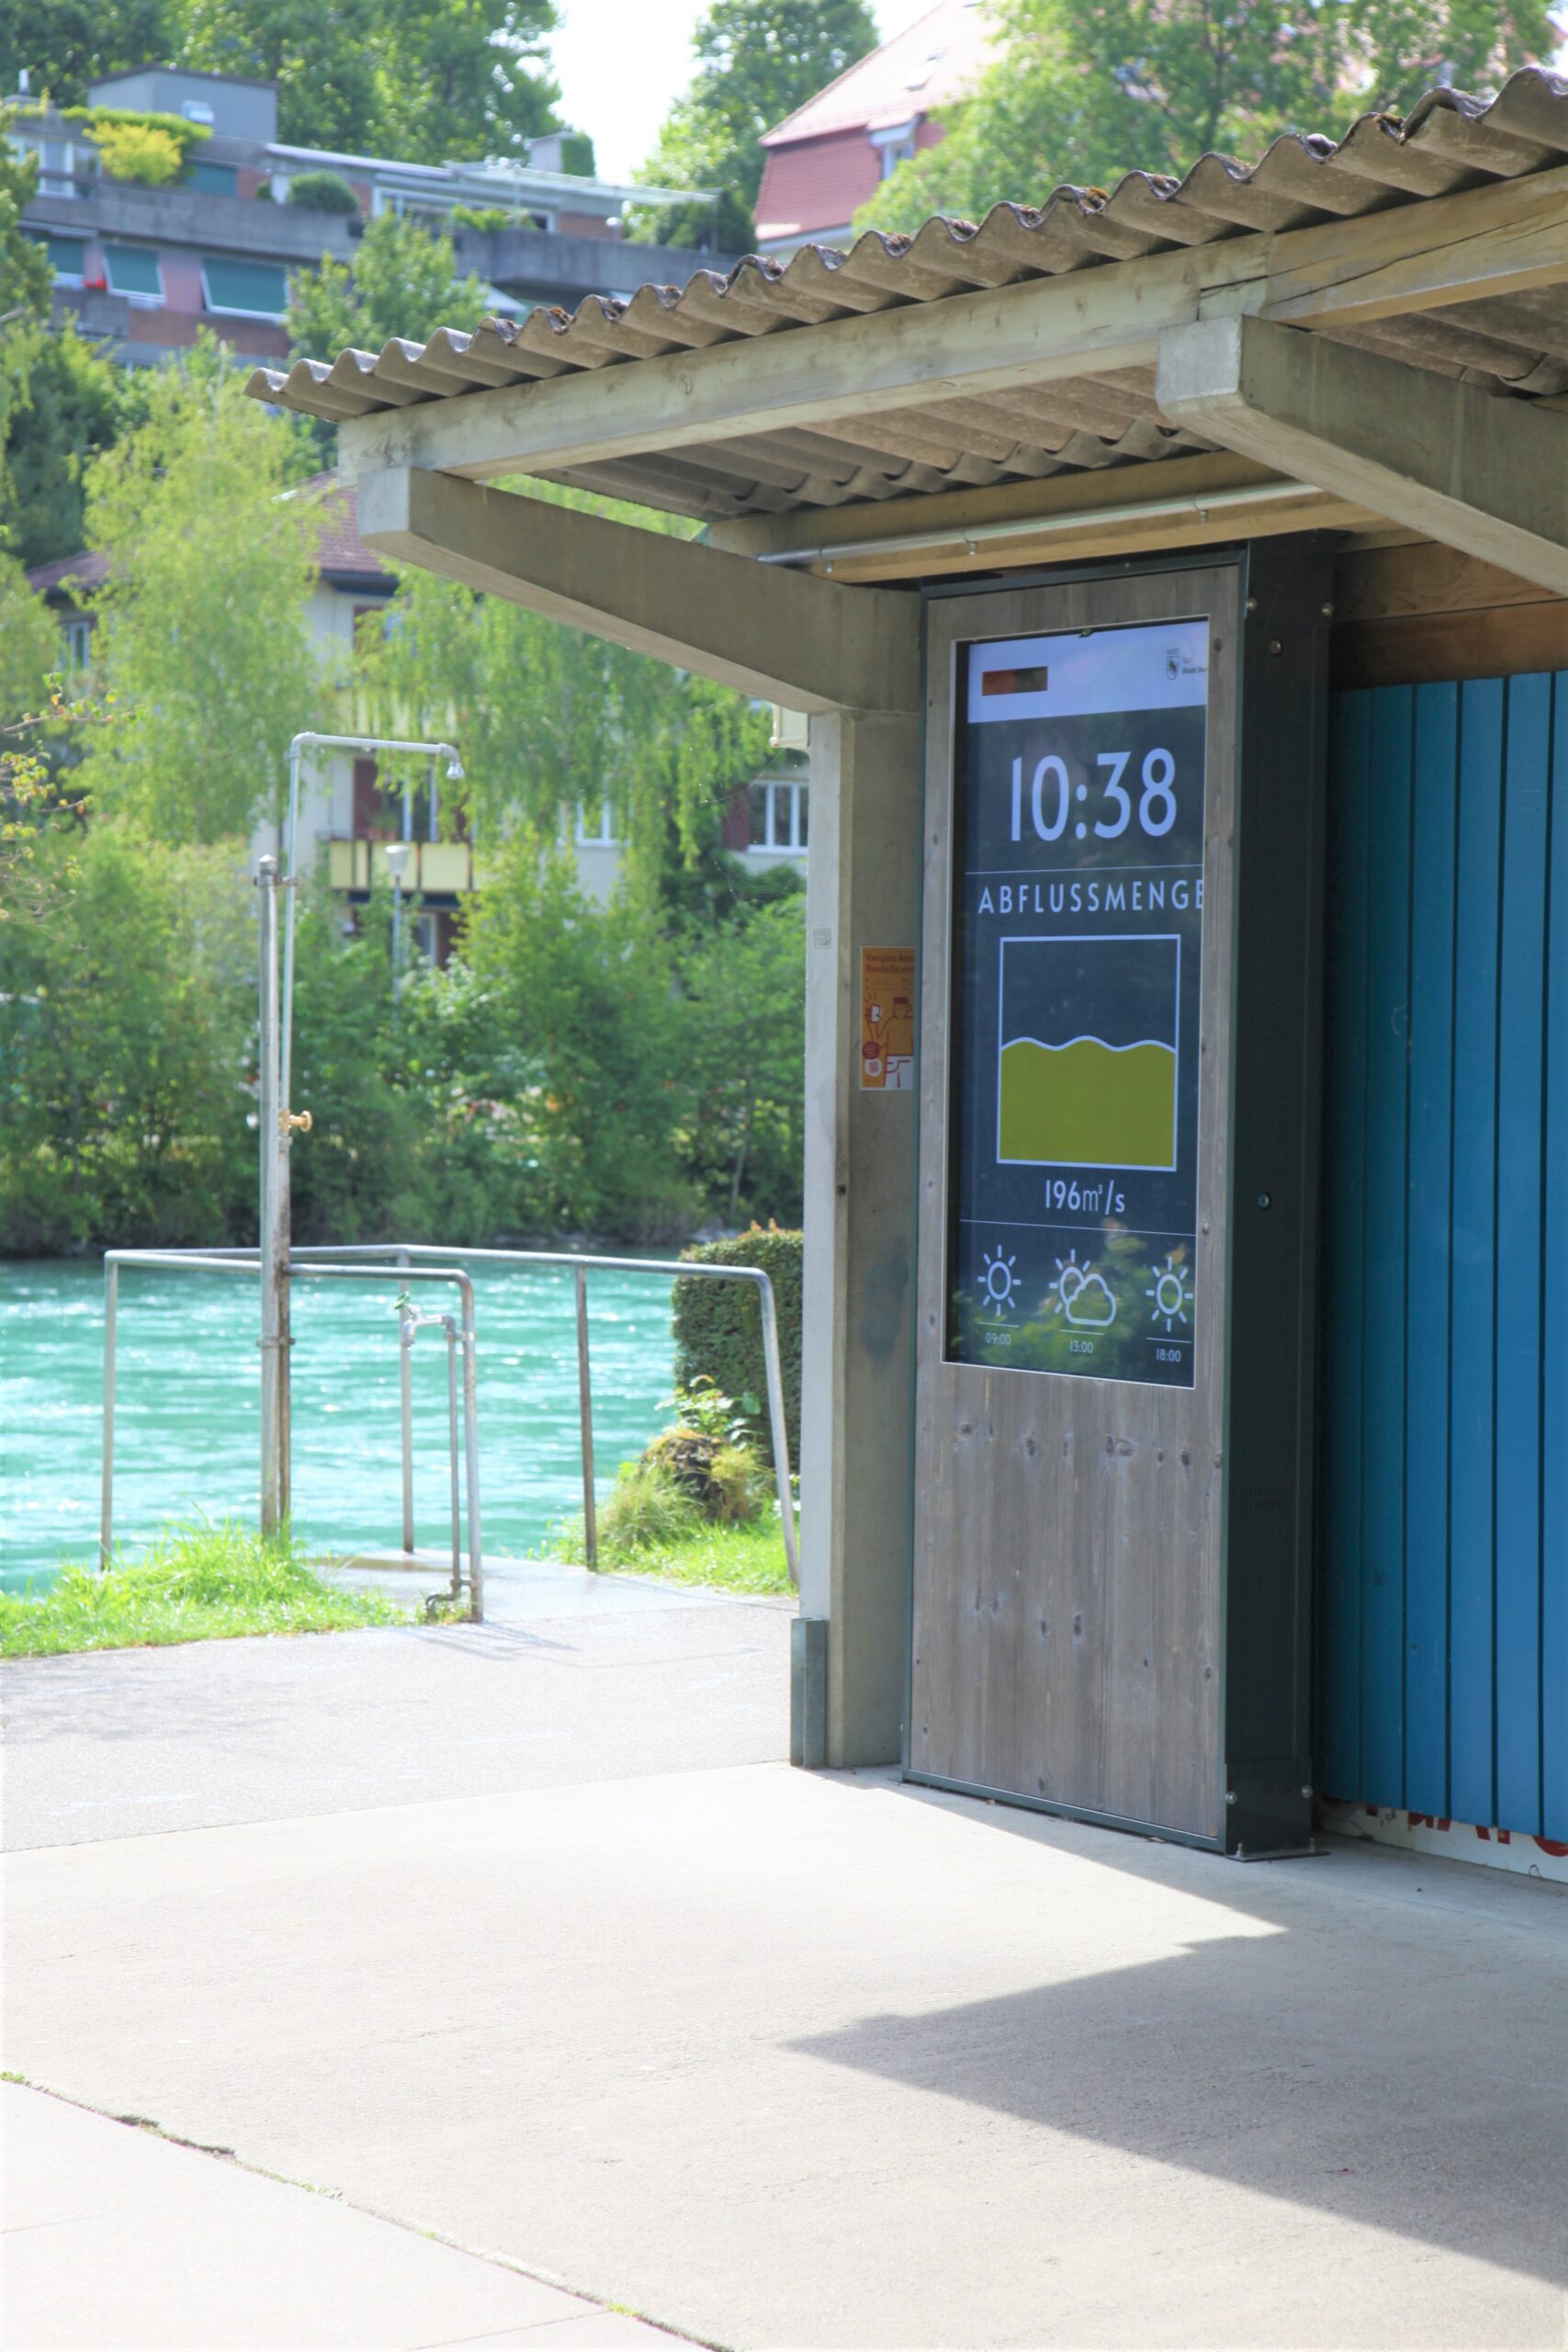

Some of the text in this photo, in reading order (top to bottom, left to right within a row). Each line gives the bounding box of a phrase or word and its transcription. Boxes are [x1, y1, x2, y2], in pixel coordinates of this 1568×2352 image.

[1011, 748, 1177, 842] 10:38
[977, 879, 1203, 914] ABFLUSSMENGE
[985, 1331, 1011, 1346] 09:00
[1069, 1340, 1094, 1354] 13:00
[1156, 1348, 1181, 1363] 18:00
